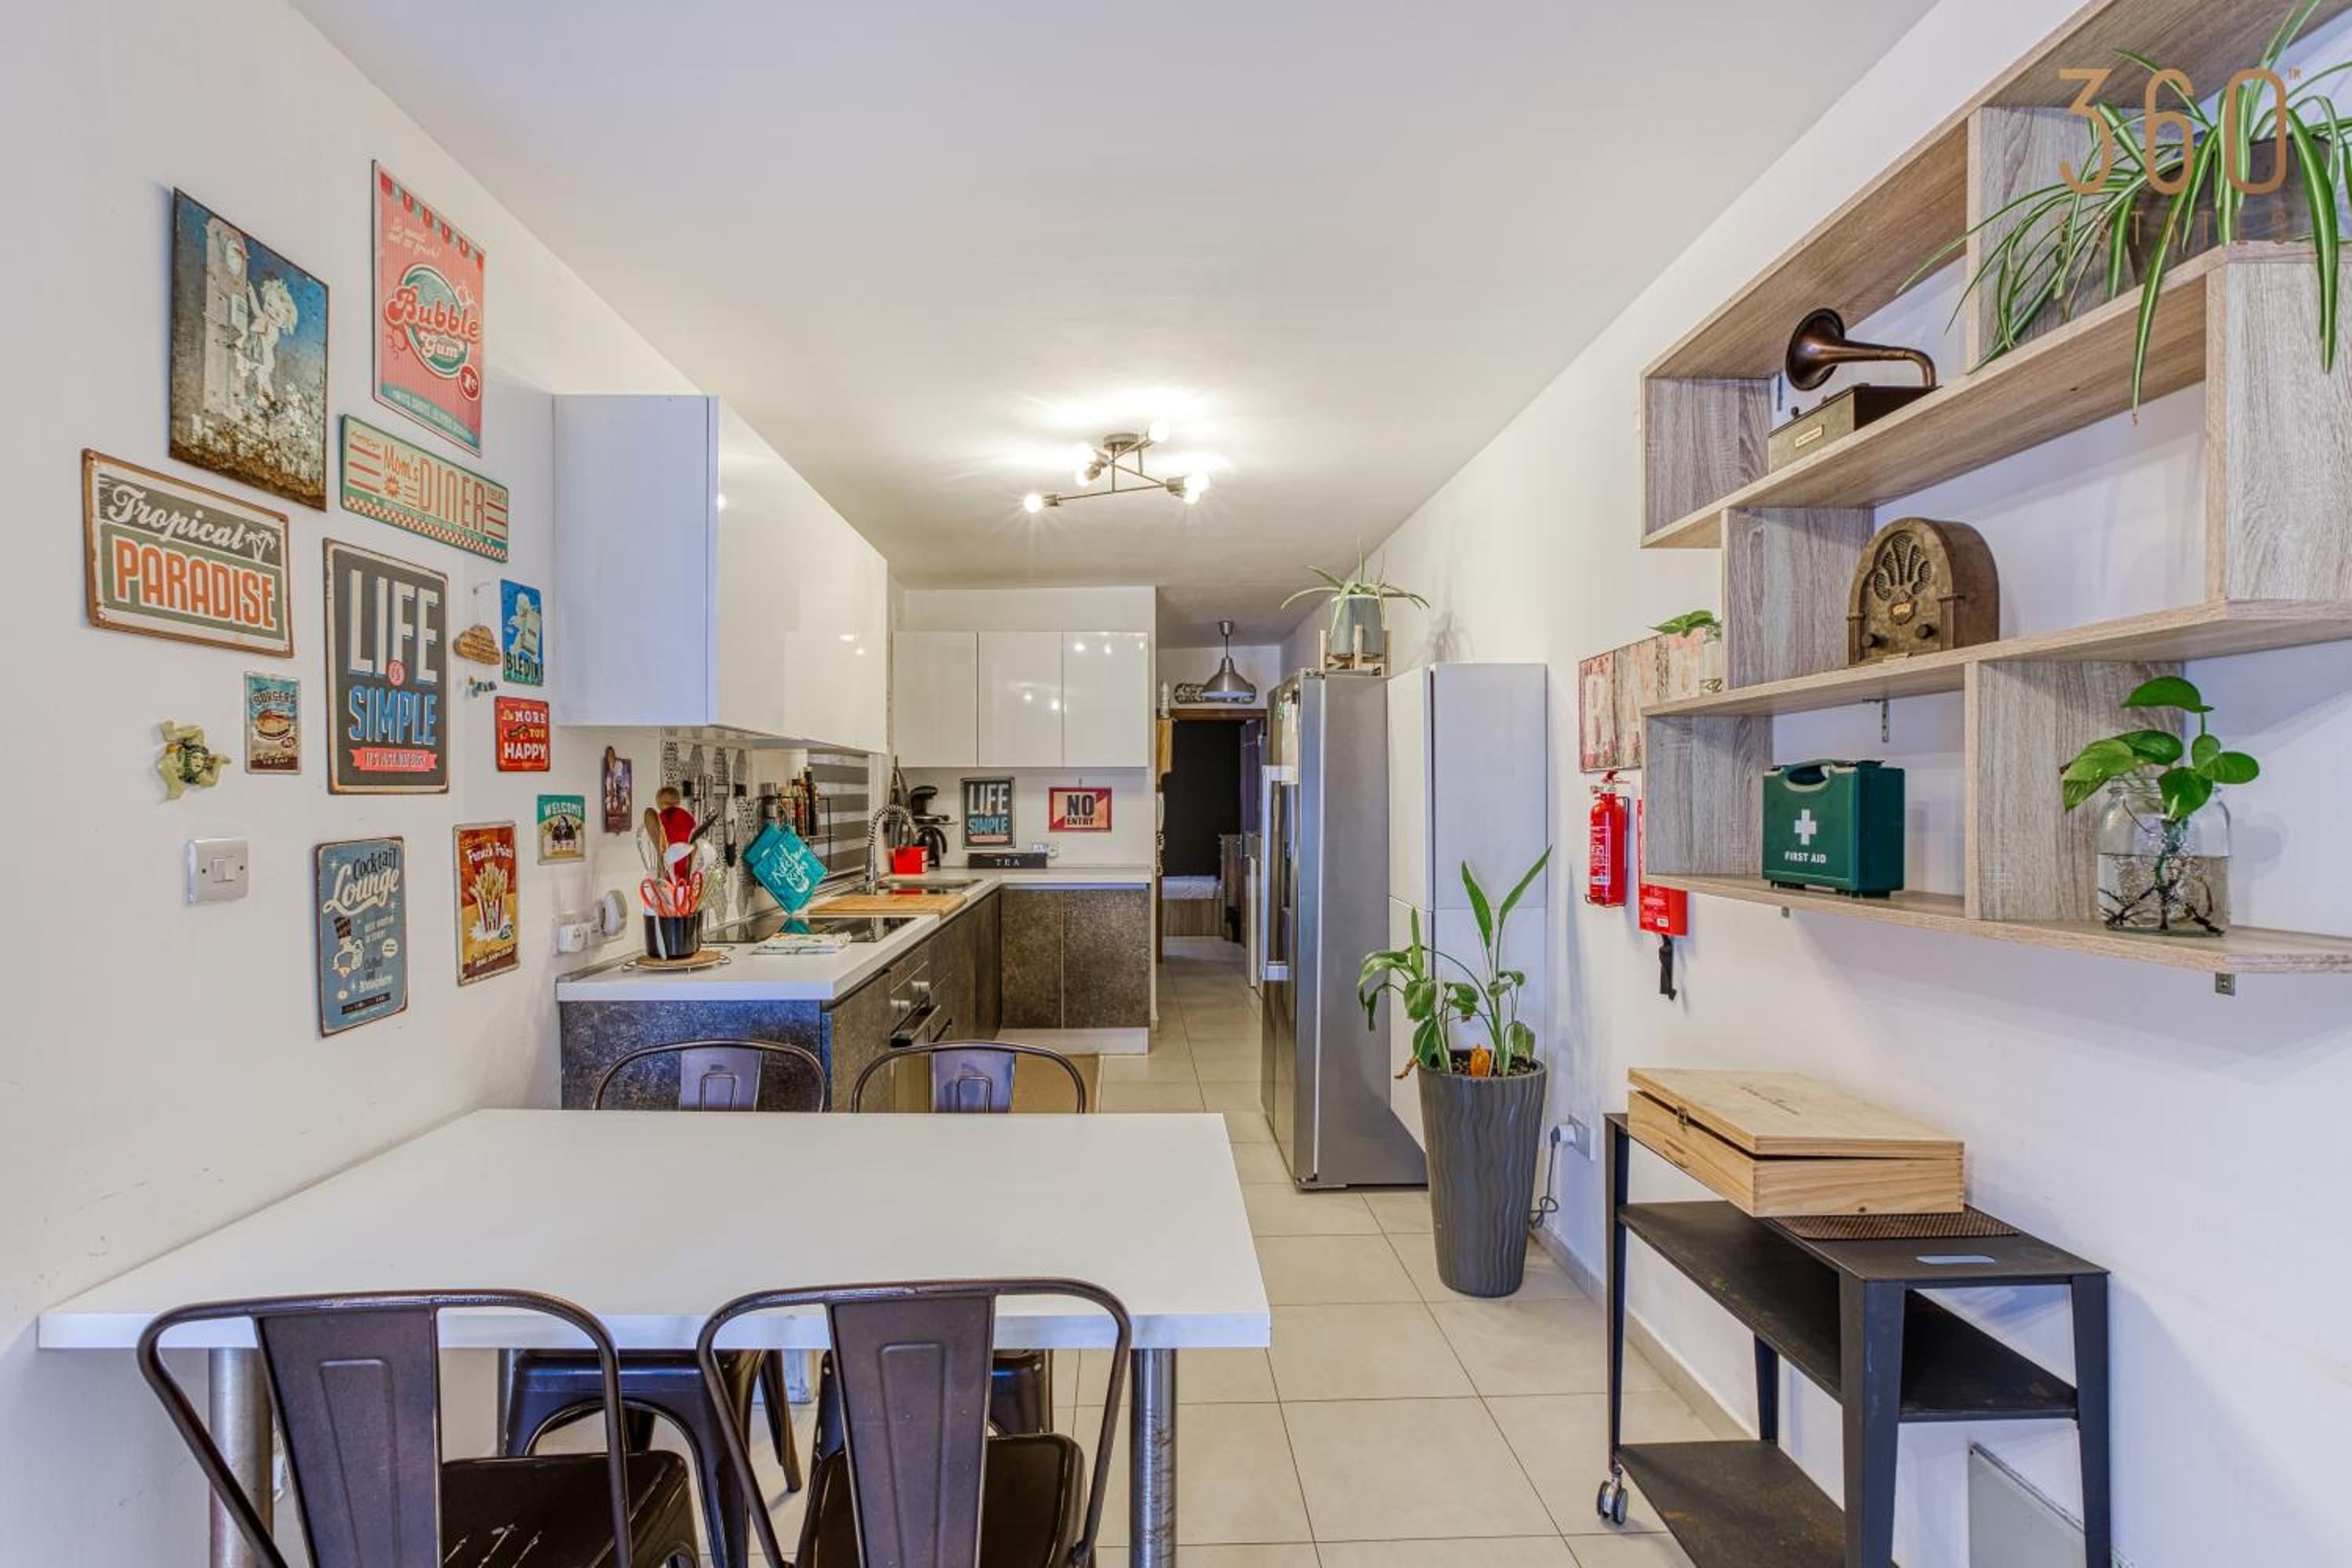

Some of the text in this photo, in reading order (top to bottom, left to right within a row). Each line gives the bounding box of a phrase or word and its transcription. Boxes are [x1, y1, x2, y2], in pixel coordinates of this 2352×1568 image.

[385, 285, 478, 341] Bubble
[419, 457, 485, 533] DINER
[107, 483, 246, 550] Tropical
[112, 535, 278, 632] PARADISE
[349, 568, 439, 686] LIFE
[348, 684, 439, 746] SIMPLE
[514, 709, 547, 724] MORE
[503, 742, 546, 760] HAPPY
[543, 802, 583, 816] WELCOME
[968, 784, 1009, 815] LIFE
[1067, 794, 1095, 816] NO
[967, 817, 1008, 835] SIMPLE
[1067, 817, 1094, 826] ENTRY
[352, 848, 397, 880] Cocktail
[995, 858, 1021, 866] TEA
[1785, 851, 1827, 864] FIRST AID
[322, 862, 399, 916] Lounge
